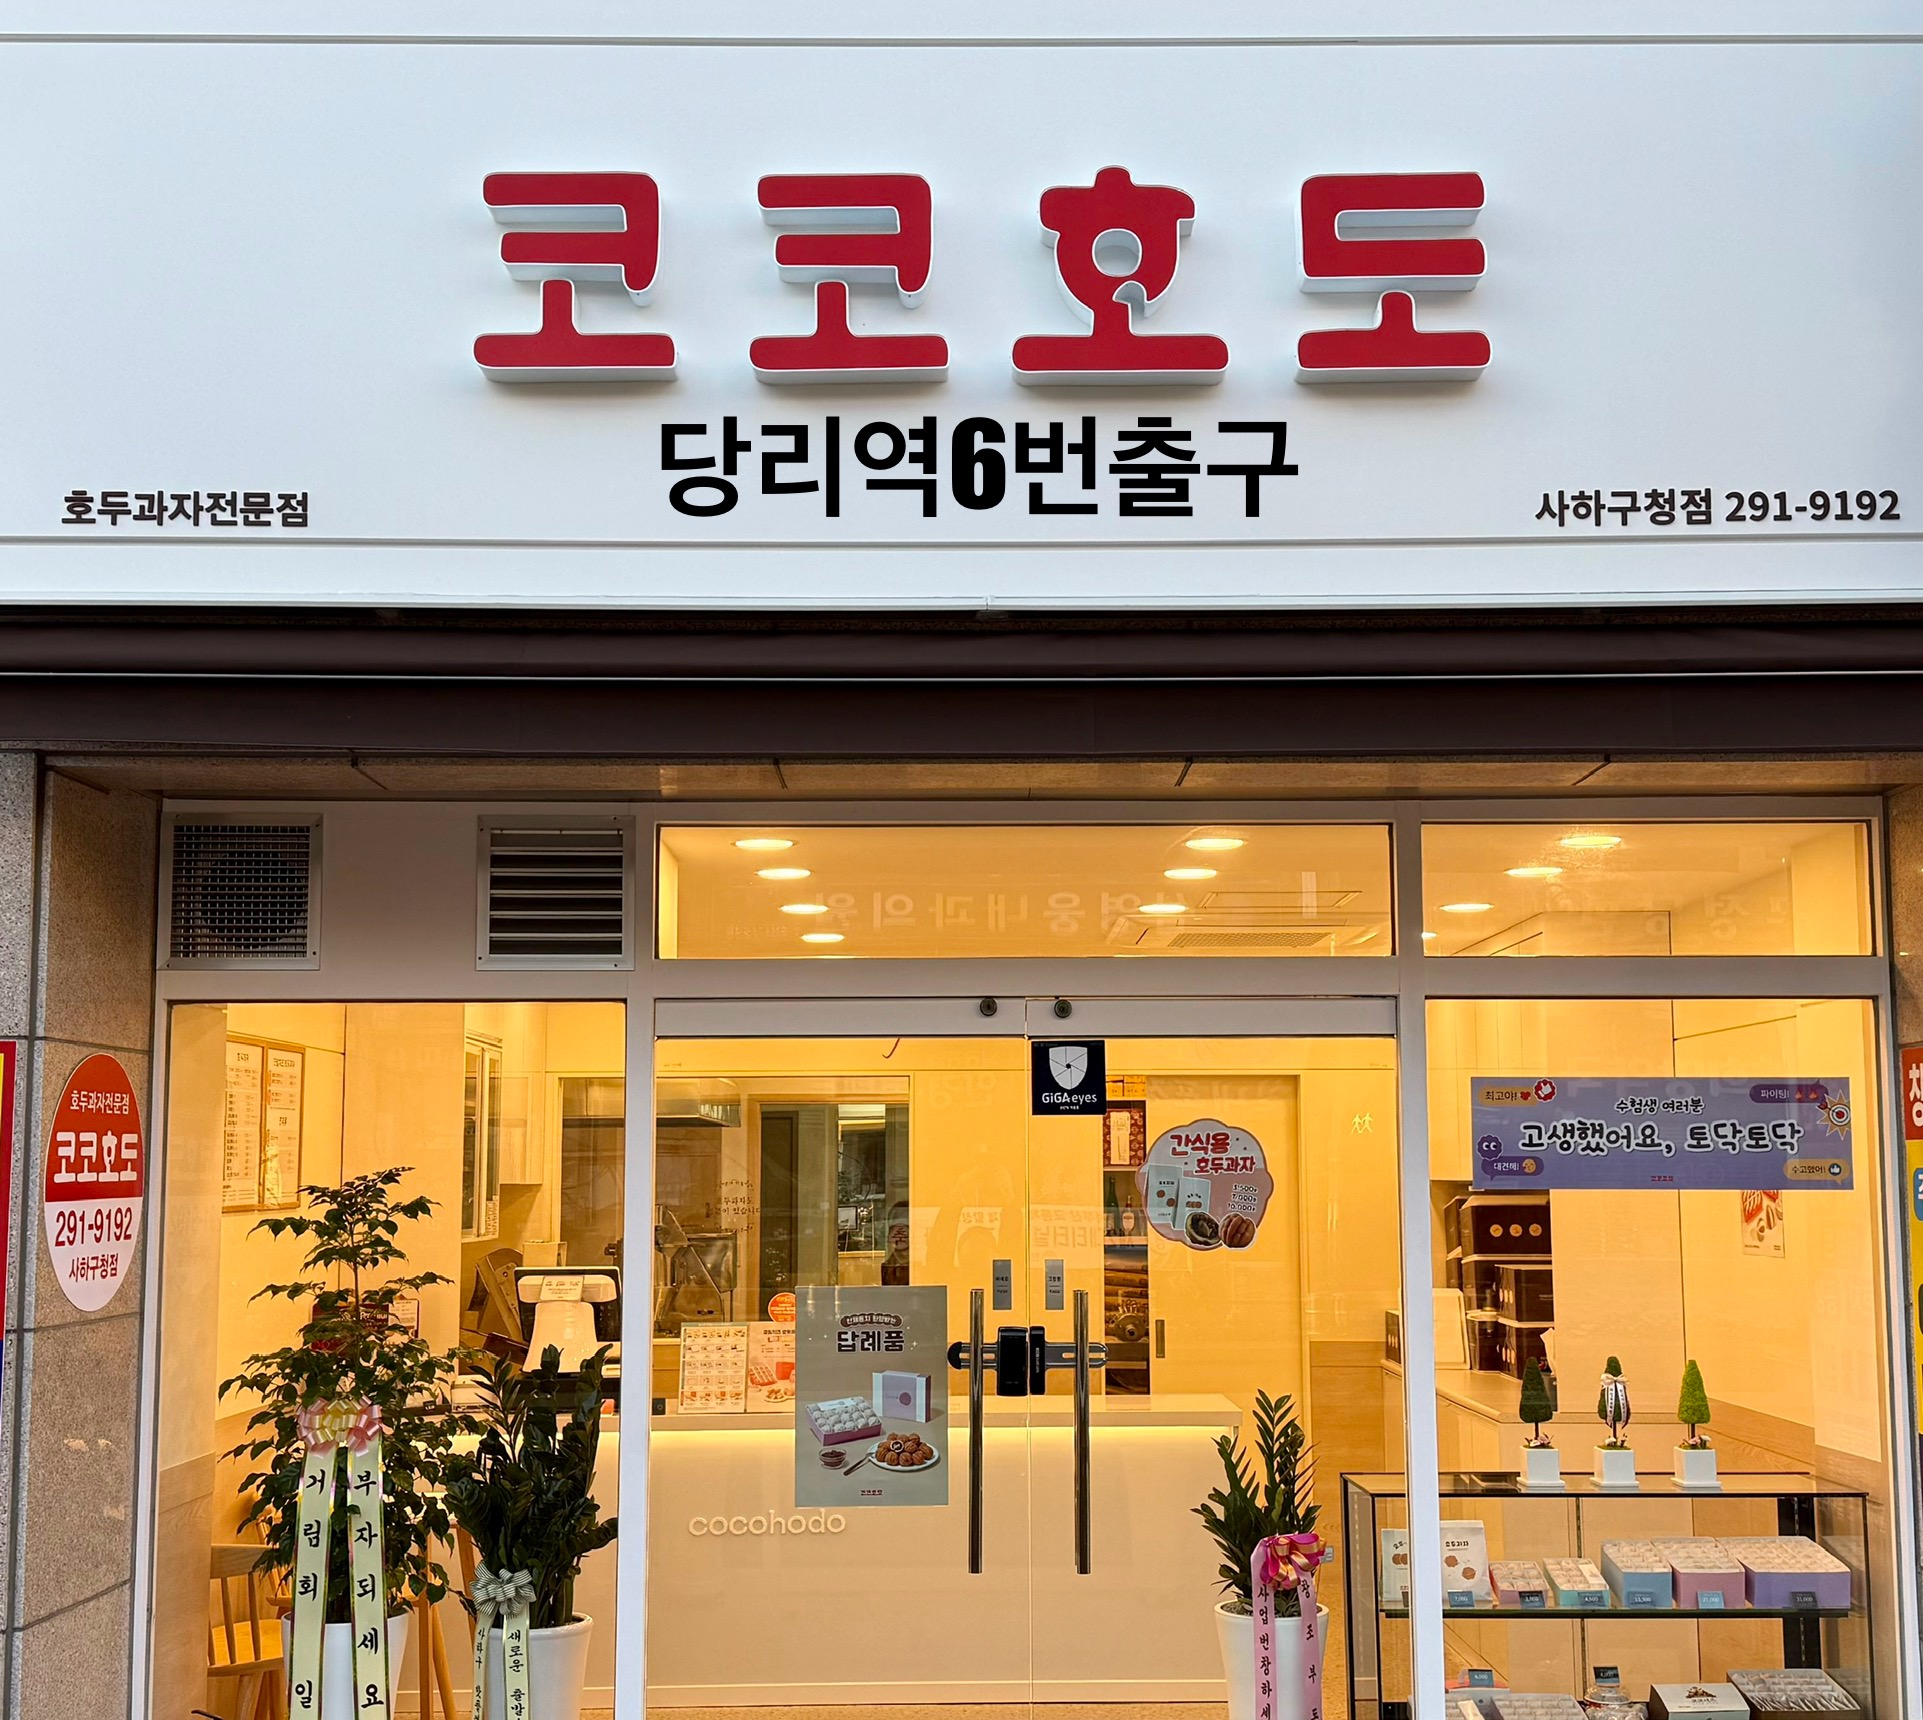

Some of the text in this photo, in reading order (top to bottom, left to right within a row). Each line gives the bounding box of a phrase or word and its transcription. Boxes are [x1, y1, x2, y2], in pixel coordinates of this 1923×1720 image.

[473, 165, 1492, 381] 코코호도
[61, 489, 309, 528] 호두과자전문점
[1535, 488, 1901, 526] 사하구청점 291-9192
[69, 1089, 131, 1116] 호두과자전문점
[1484, 1089, 1518, 1102] 최고야!
[1614, 1097, 1704, 1114] 수험생 여러분
[1169, 1132, 1231, 1157] 간식용
[1519, 1119, 1804, 1156] 고생했어요, 토닥토닥
[53, 1130, 139, 1184] 코코호도
[1194, 1155, 1256, 1175] 호두과자
[54, 1206, 133, 1247] 291-9192
[68, 1252, 119, 1283] 사하구청점
[836, 1330, 905, 1353] 답례품
[688, 1508, 847, 1537] cocohodo
[353, 1469, 384, 1709] 부자되세요
[507, 1629, 524, 1673] 새로운
